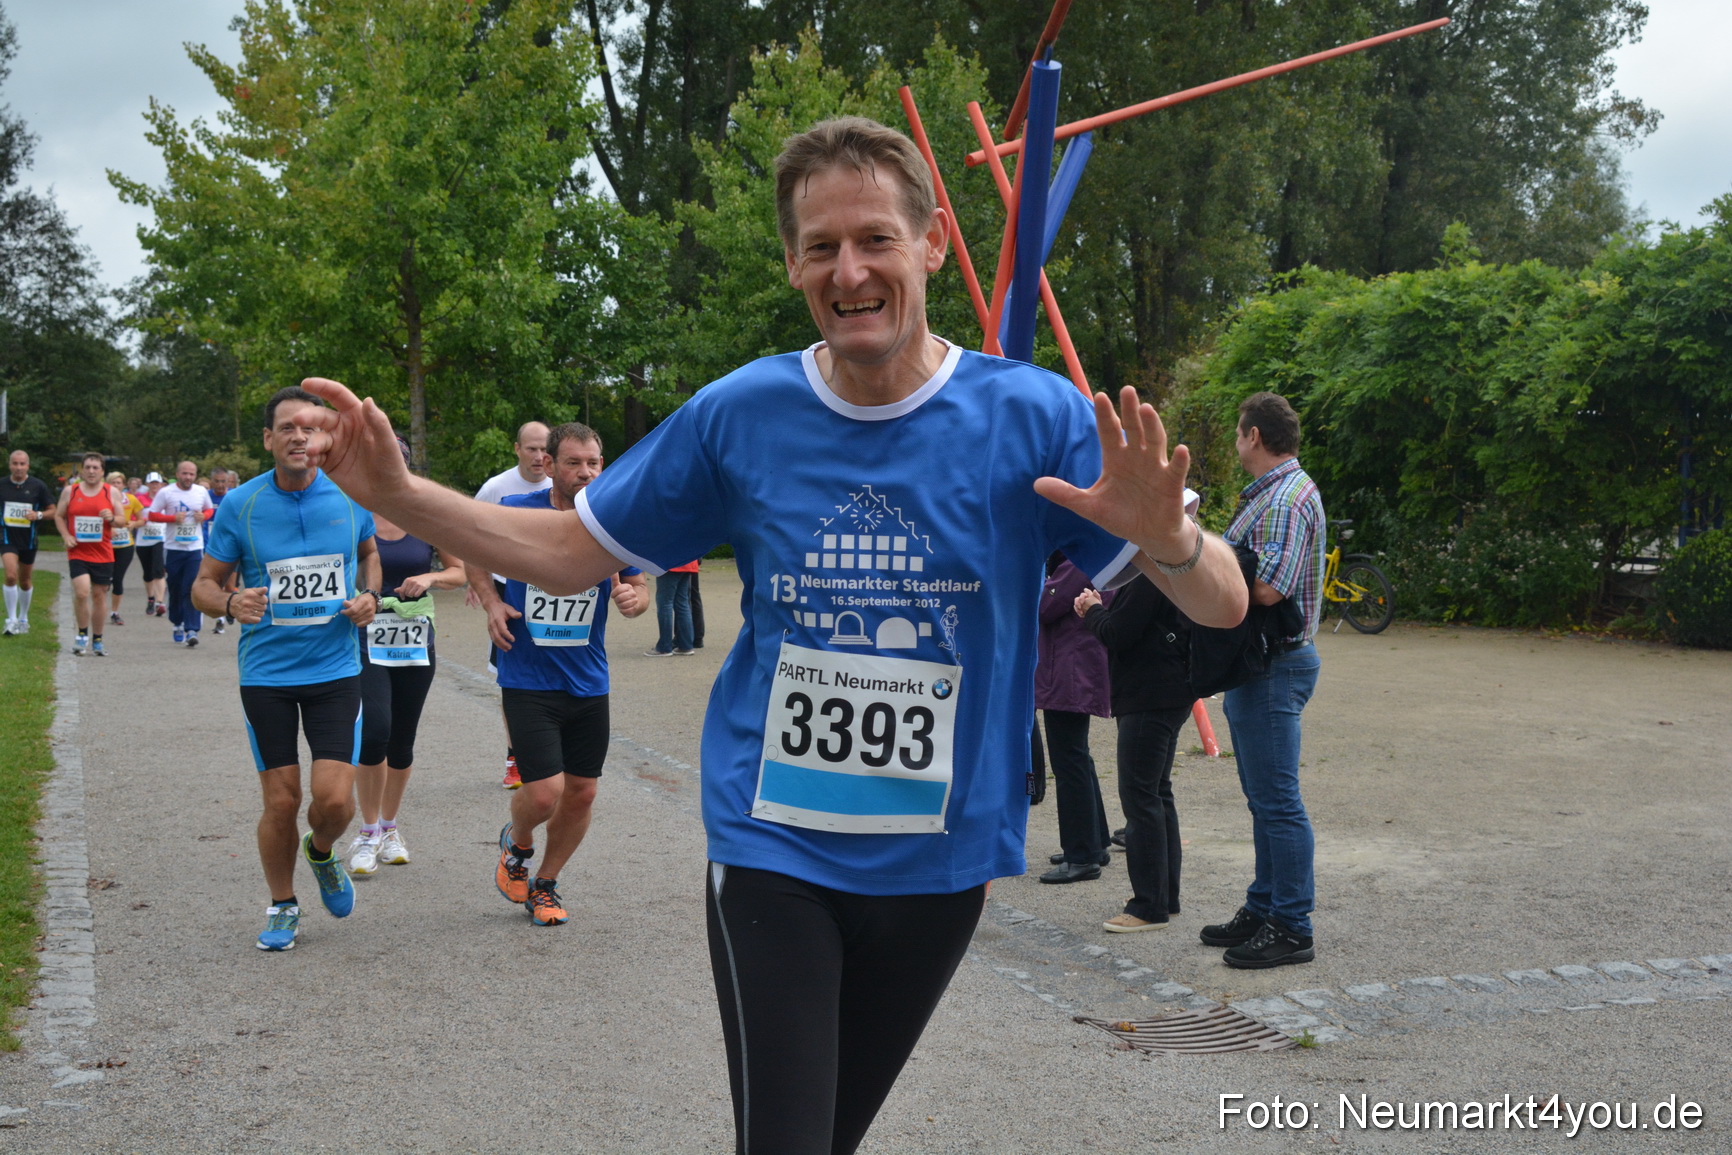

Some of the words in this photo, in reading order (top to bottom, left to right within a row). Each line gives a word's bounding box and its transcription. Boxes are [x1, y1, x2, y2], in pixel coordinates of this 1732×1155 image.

[77, 522, 101, 533] 2216
[269, 565, 294, 575] PARTL
[296, 562, 331, 571] Neumarkt
[278, 571, 339, 600] 2824
[770, 573, 808, 604] 13.
[800, 575, 898, 591] Neumarkter
[903, 578, 981, 593] Stadtlauf
[292, 605, 326, 617] Jürgen
[531, 596, 591, 622] 2177
[915, 598, 941, 608] 2012
[374, 625, 422, 645] 2712
[545, 627, 572, 638] Armin
[387, 650, 411, 659] Katrin
[778, 661, 829, 686] PARTL
[834, 671, 925, 696] Neumarkt
[781, 691, 935, 771] 3393
